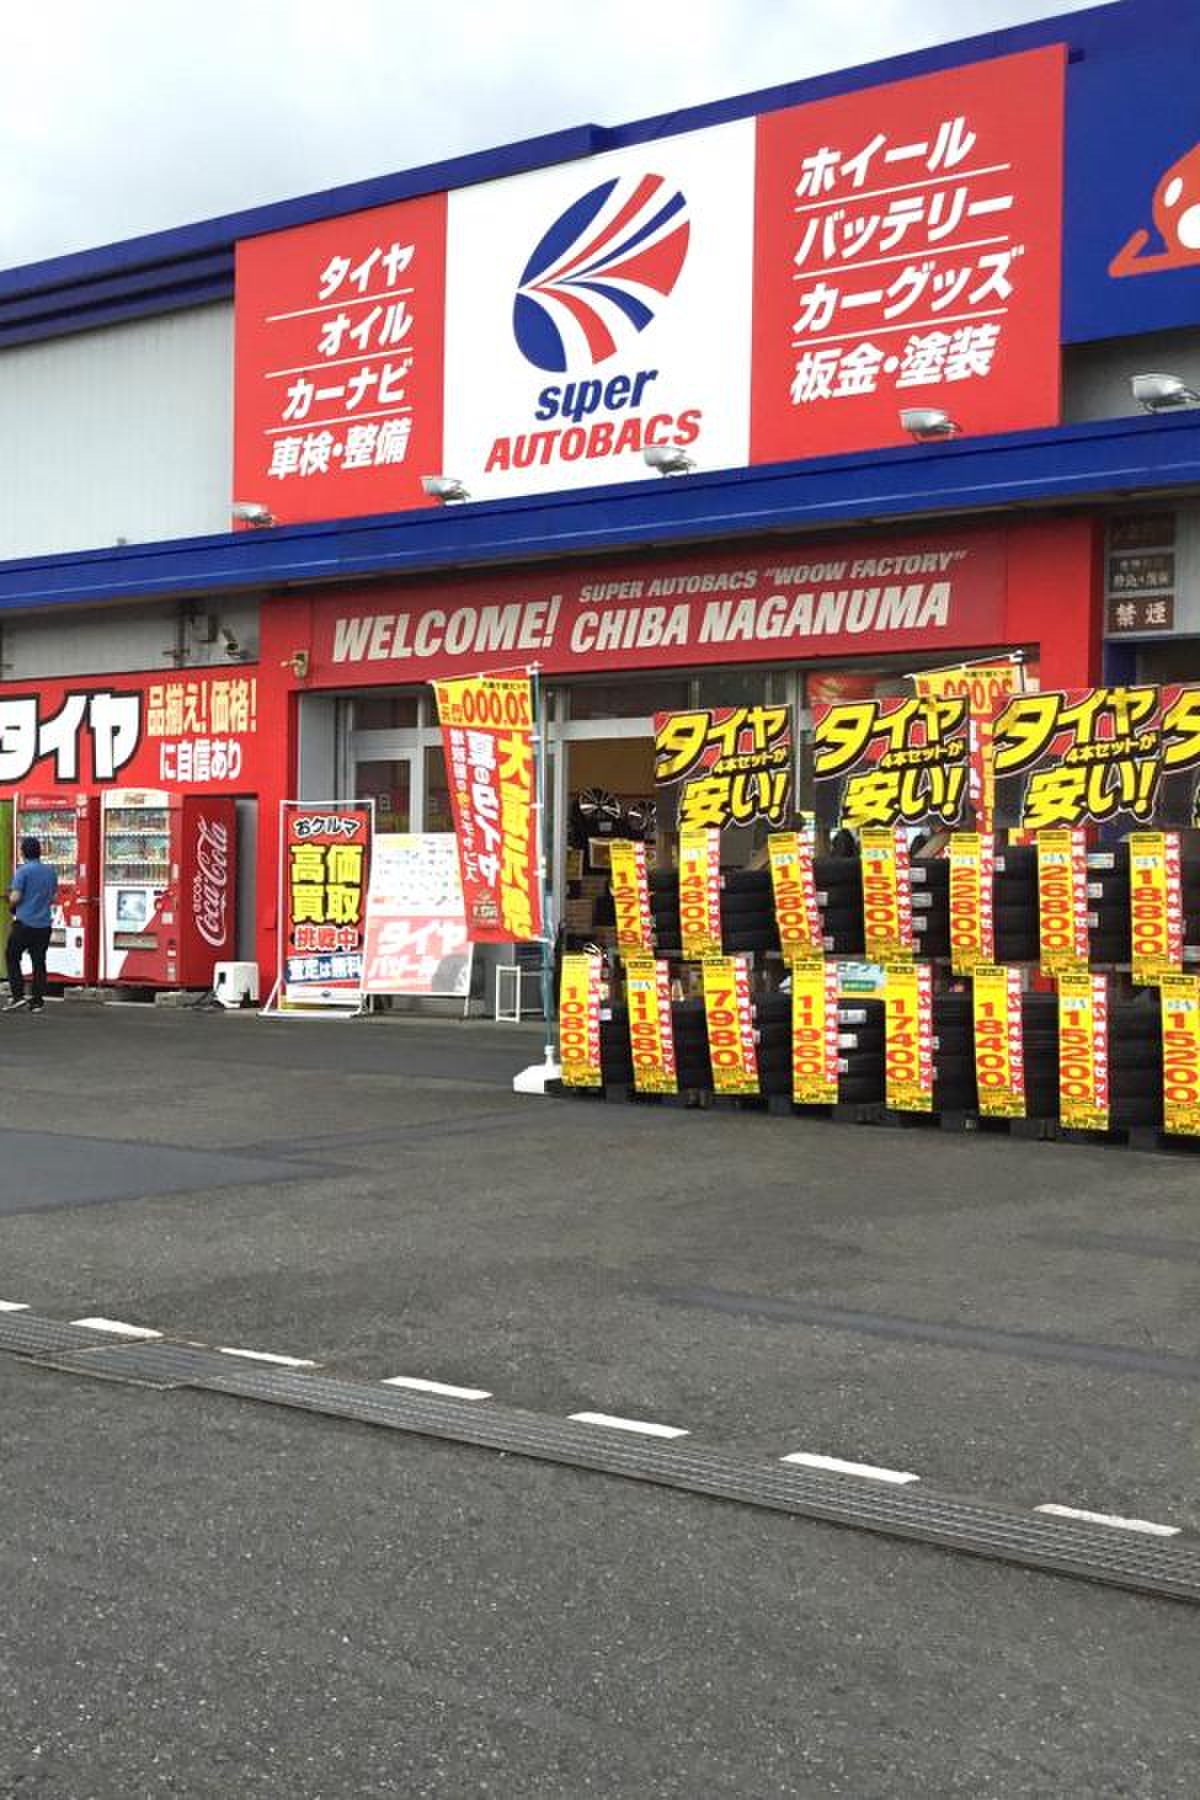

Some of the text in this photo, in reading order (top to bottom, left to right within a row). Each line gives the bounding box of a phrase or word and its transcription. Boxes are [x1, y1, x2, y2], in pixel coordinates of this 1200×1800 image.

[795, 116, 977, 197] ホイール
[794, 187, 1014, 266] バッテリー
[317, 242, 415, 300] タイヤ
[792, 244, 1025, 333] カーグッズ
[318, 301, 414, 355] オイル
[282, 357, 414, 420] カーナビ
[790, 323, 1000, 404] 板金・塗装
[534, 369, 659, 423] super
[267, 417, 412, 479] 車検・整備
[484, 409, 702, 473] AUTOBACS
[579, 581, 642, 602] SUPER
[649, 570, 757, 596] AUTOBACS
[332, 582, 951, 663] WELCOME! CHIBA NAGANUMA
[160, 738, 241, 782] に自信あり
[655, 705, 788, 778] タイヤ
[816, 699, 966, 774] タイヤ
[994, 688, 1156, 769] タイヤ
[681, 768, 787, 831] 安い!
[841, 767, 964, 830] 安い!
[1023, 761, 1156, 828] 安い!
[294, 815, 361, 839] おクルマ
[290, 843, 364, 885] 高価
[291, 884, 361, 925] 買取
